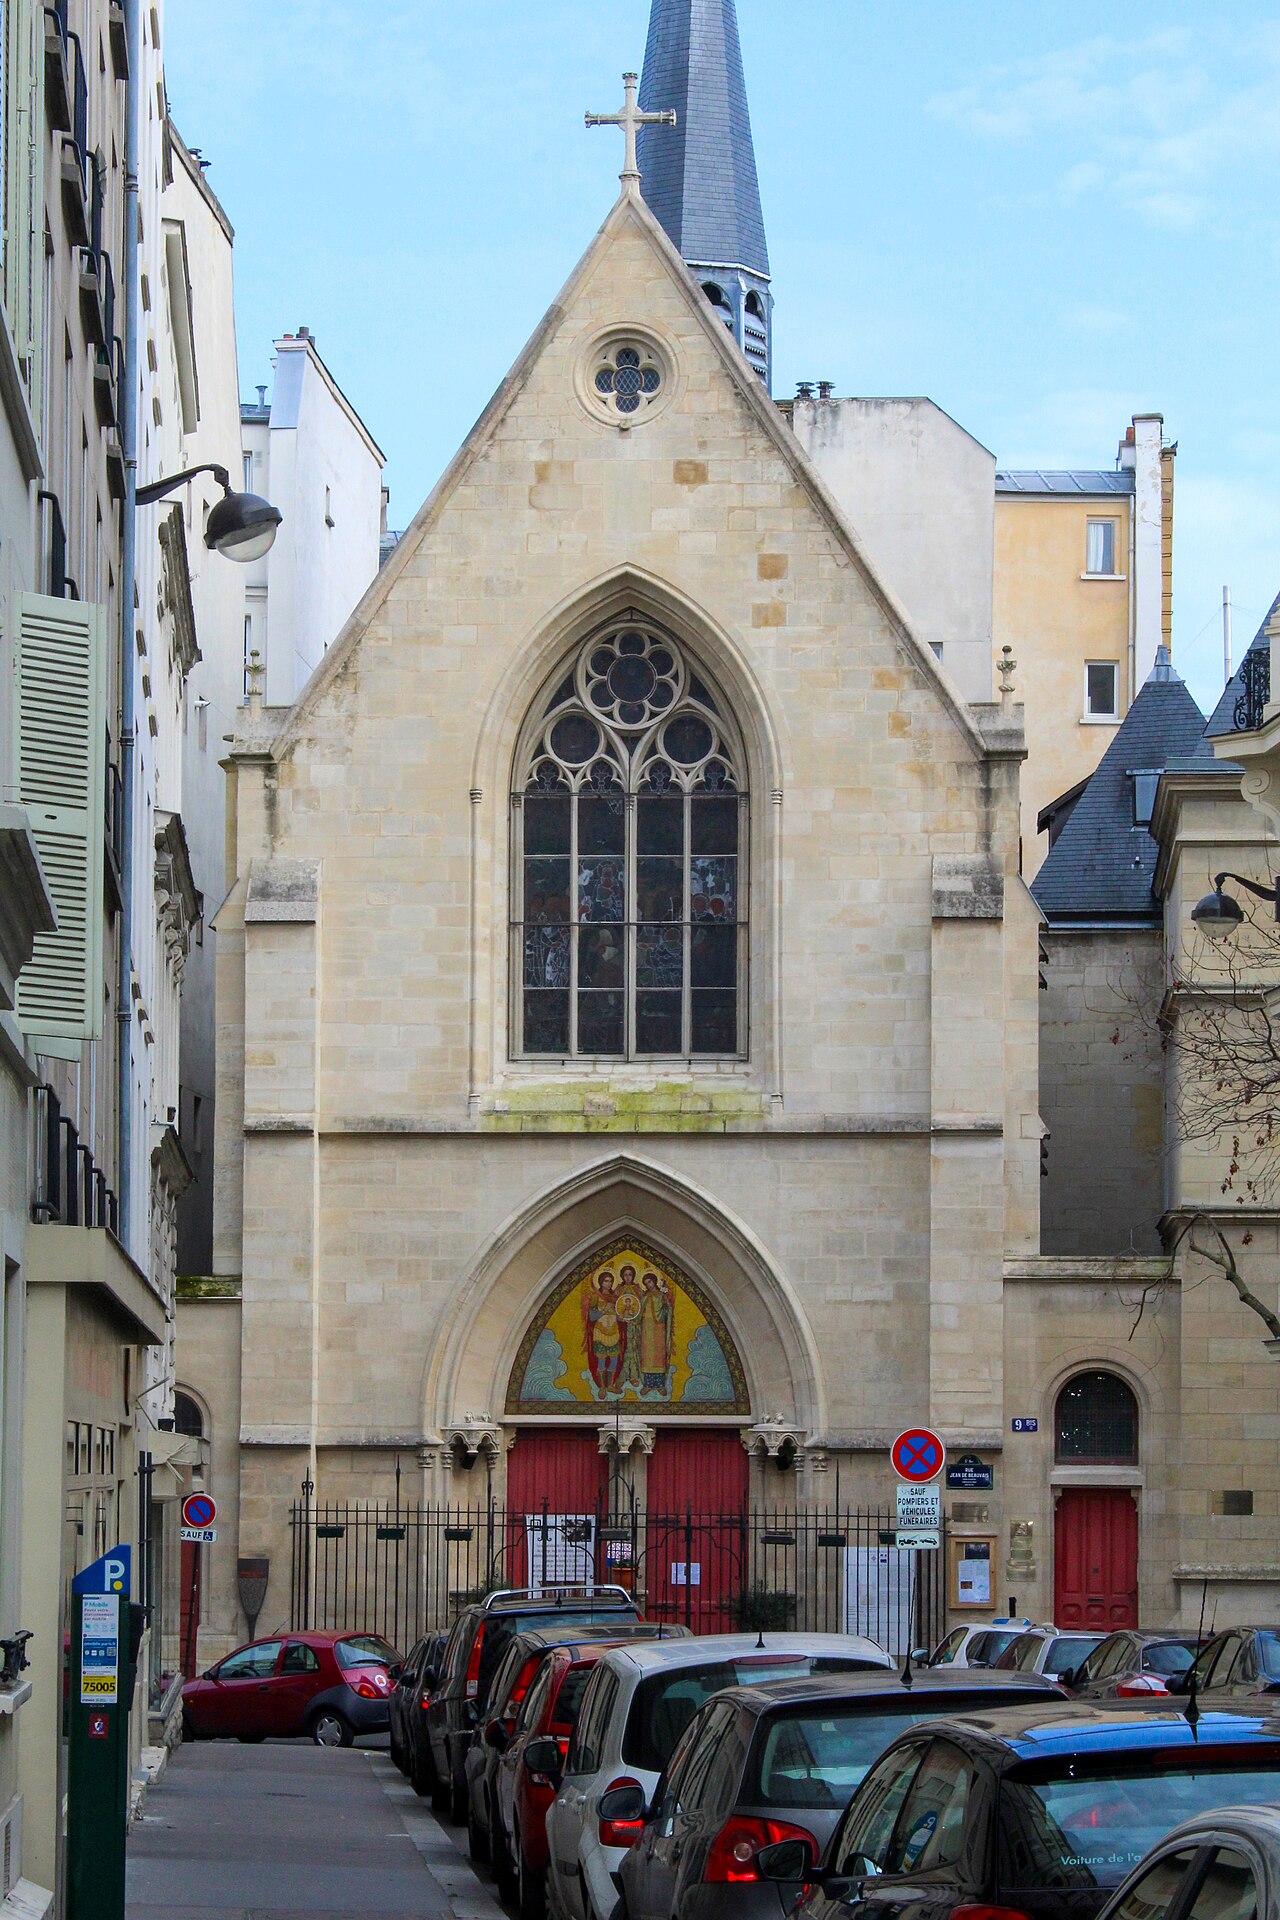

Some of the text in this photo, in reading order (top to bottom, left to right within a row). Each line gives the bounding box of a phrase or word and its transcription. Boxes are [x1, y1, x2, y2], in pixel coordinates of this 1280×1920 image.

[1015, 1419, 1022, 1430] 9
[910, 1487, 926, 1496] SAUF
[897, 1497, 939, 1505] POMPIERS ET
[901, 1505, 936, 1516] VÉHICULES
[180, 1530, 203, 1539] SAUF
[104, 1559, 125, 1592] P
[83, 1682, 116, 1692] 75005
[1060, 1855, 1105, 1865] Voiture
[1108, 1853, 1124, 1863] de
